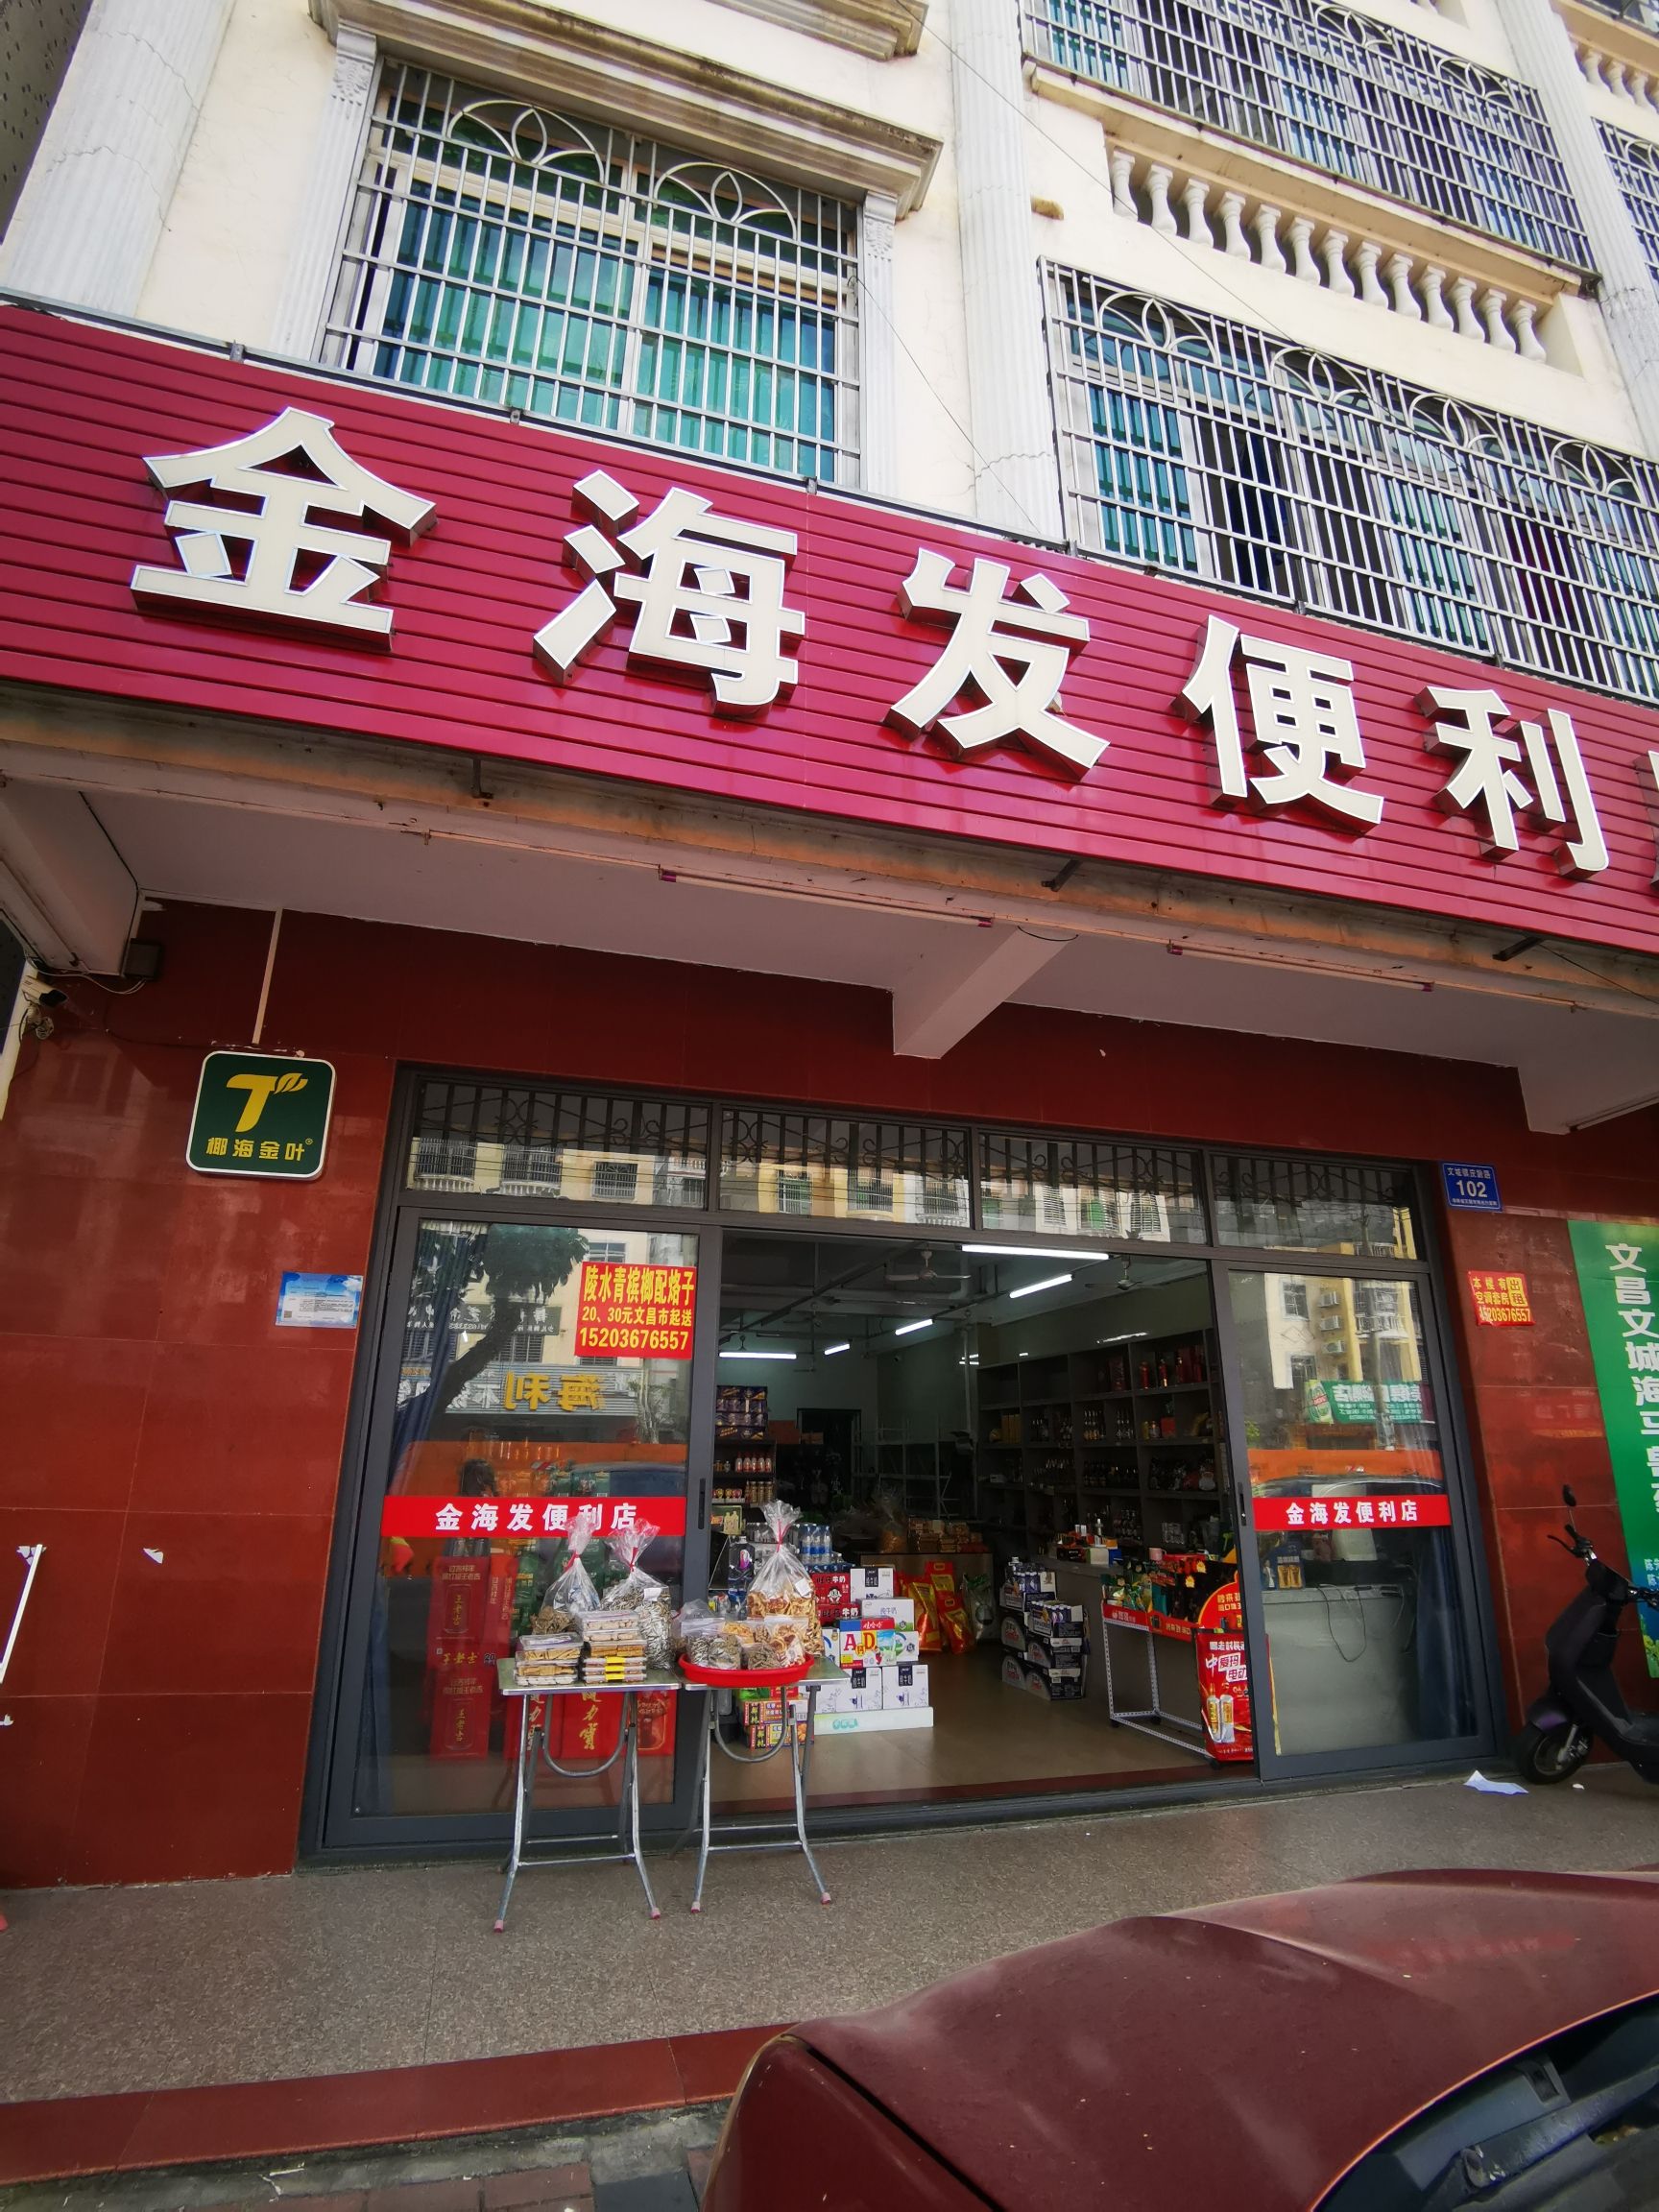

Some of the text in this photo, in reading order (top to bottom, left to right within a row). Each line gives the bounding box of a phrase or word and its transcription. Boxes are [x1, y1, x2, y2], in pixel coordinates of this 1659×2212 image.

[131, 407, 1659, 871] 金海发便利
[205, 1137, 305, 1162] 椰海金叶
[1455, 1180, 1487, 1198] 102
[580, 1327, 689, 1351] 15203676557
[435, 1502, 637, 1531] 金海发便利店
[1286, 1499, 1419, 1526] 金海发便利店
